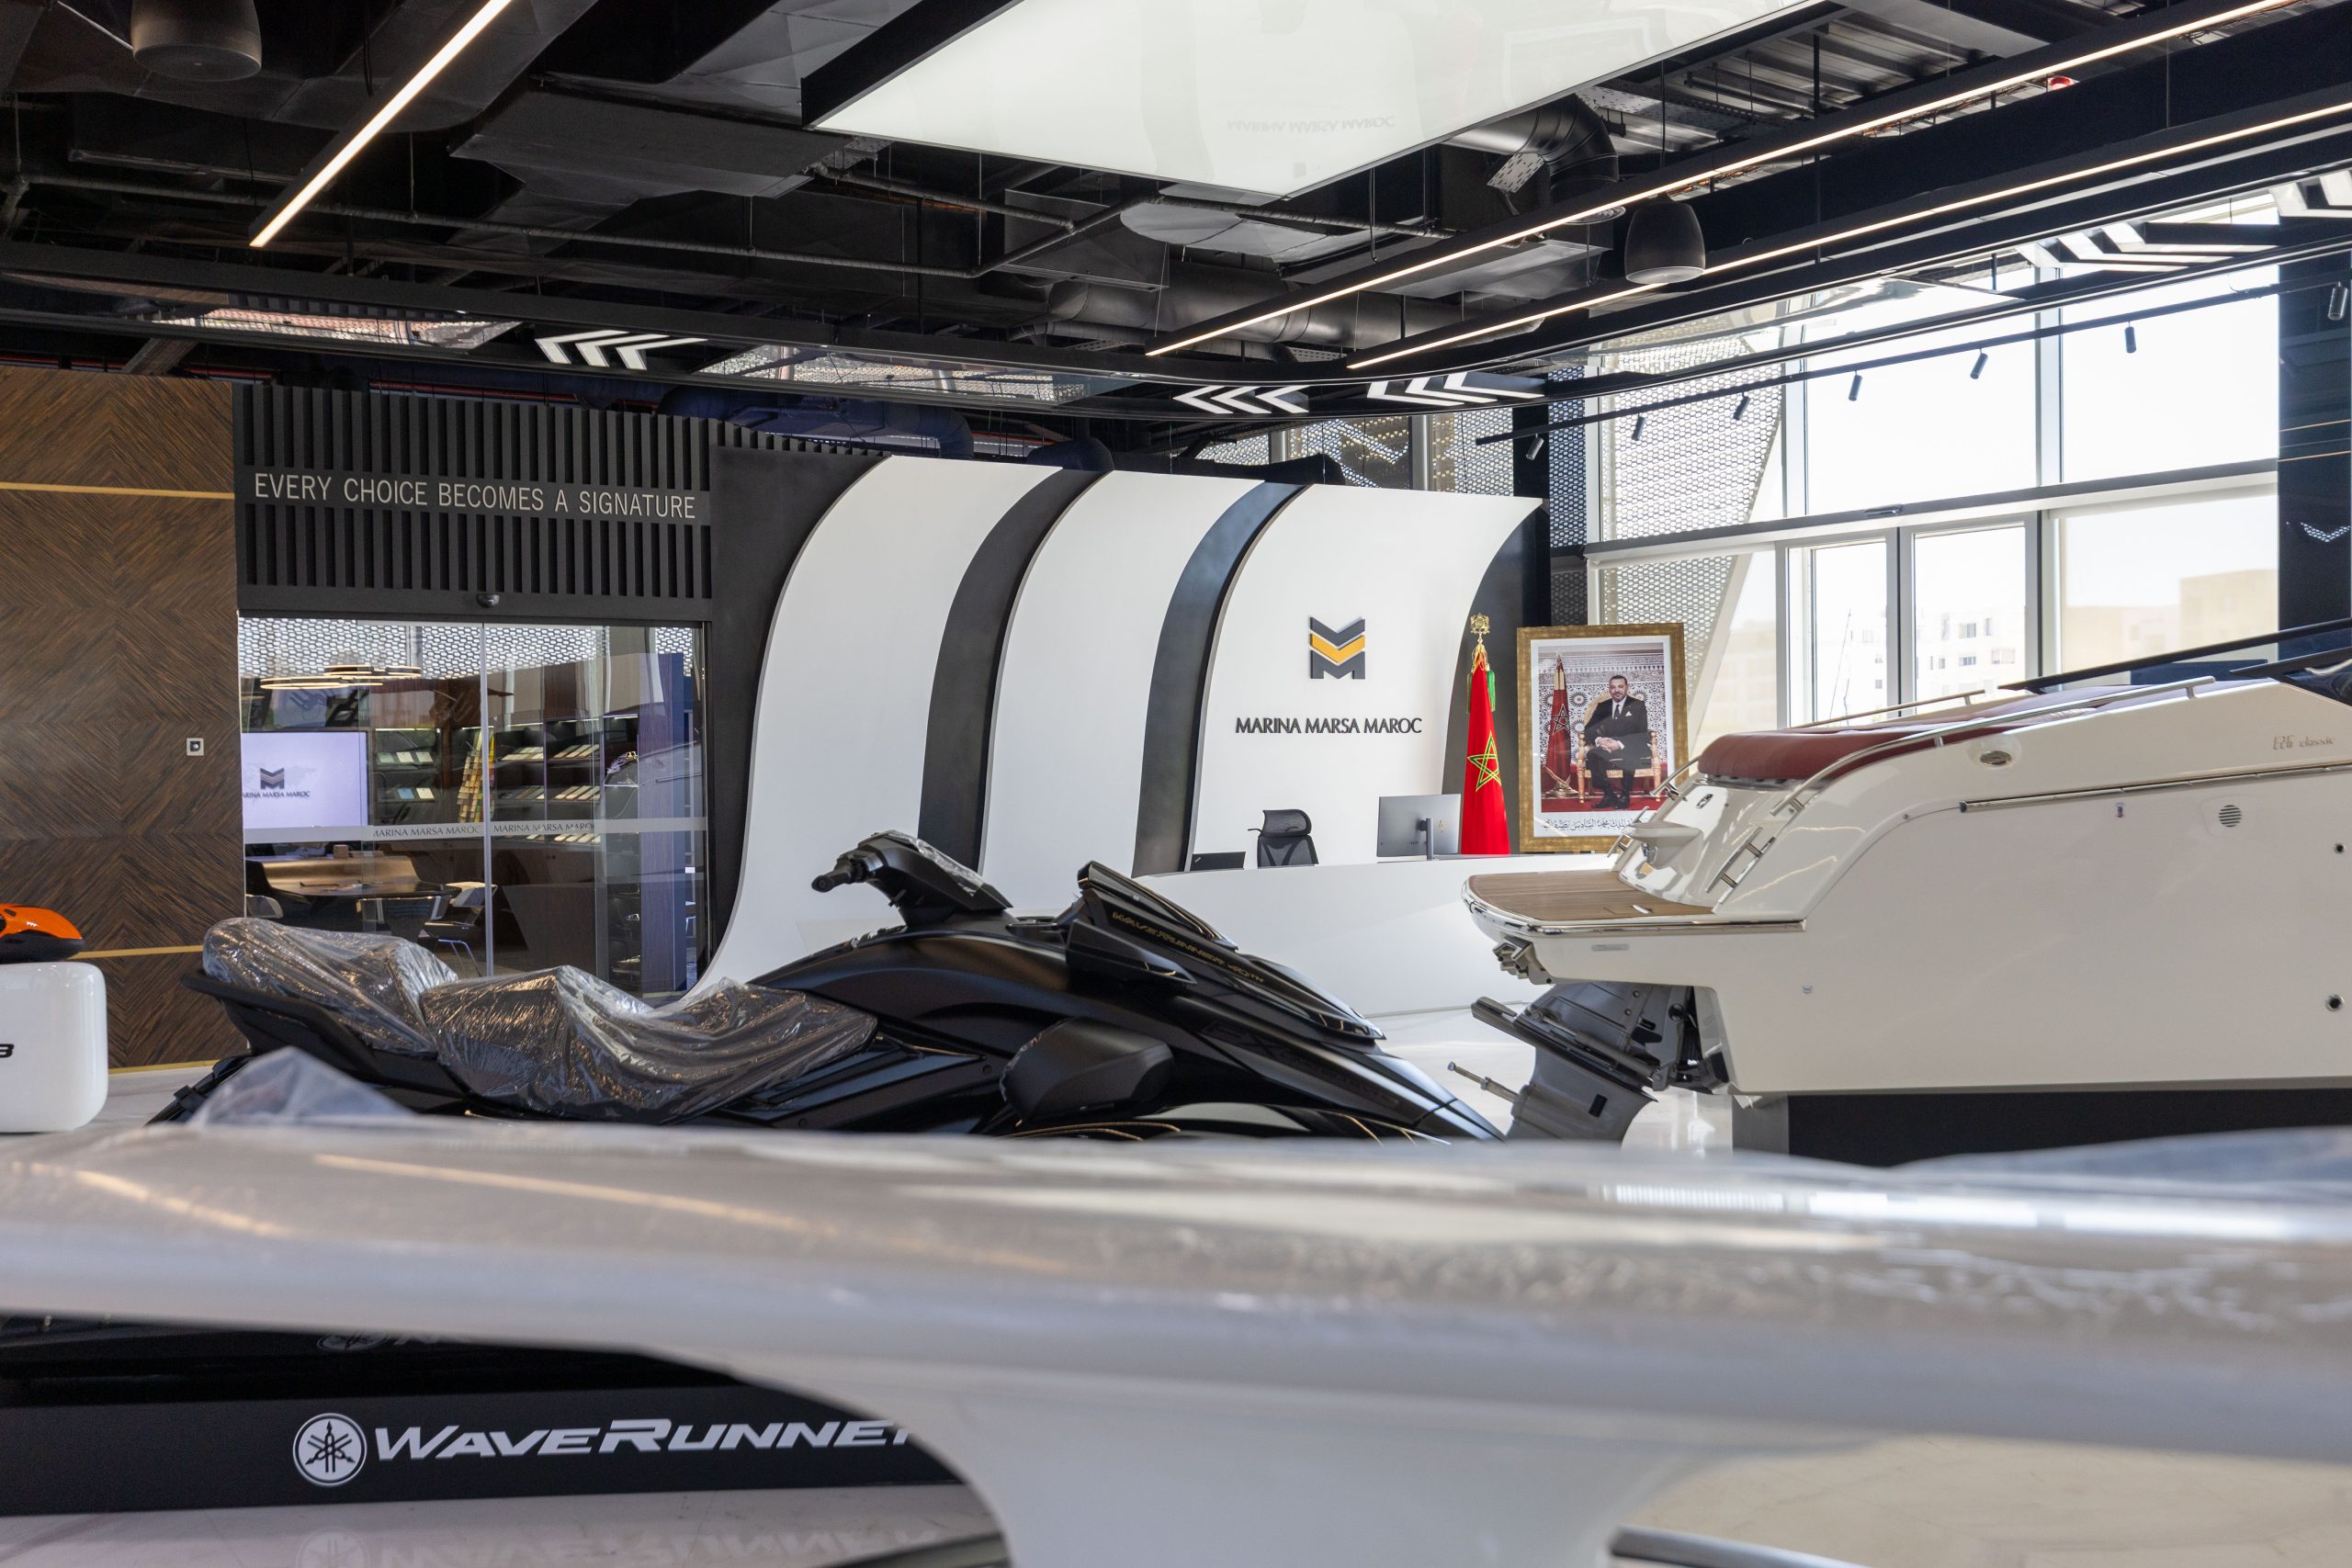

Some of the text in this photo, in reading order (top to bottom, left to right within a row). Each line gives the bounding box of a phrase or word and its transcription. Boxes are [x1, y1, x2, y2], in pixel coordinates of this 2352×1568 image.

[254, 473, 695, 519] EVERY CHOICE BECOMES A SIGNATURE
[1235, 717, 1422, 734] MARINA MARSA MAROC
[411, 828, 444, 836] MARSA
[446, 826, 481, 835] MAROC
[493, 824, 530, 833] MARINA
[533, 823, 563, 832] MARSA
